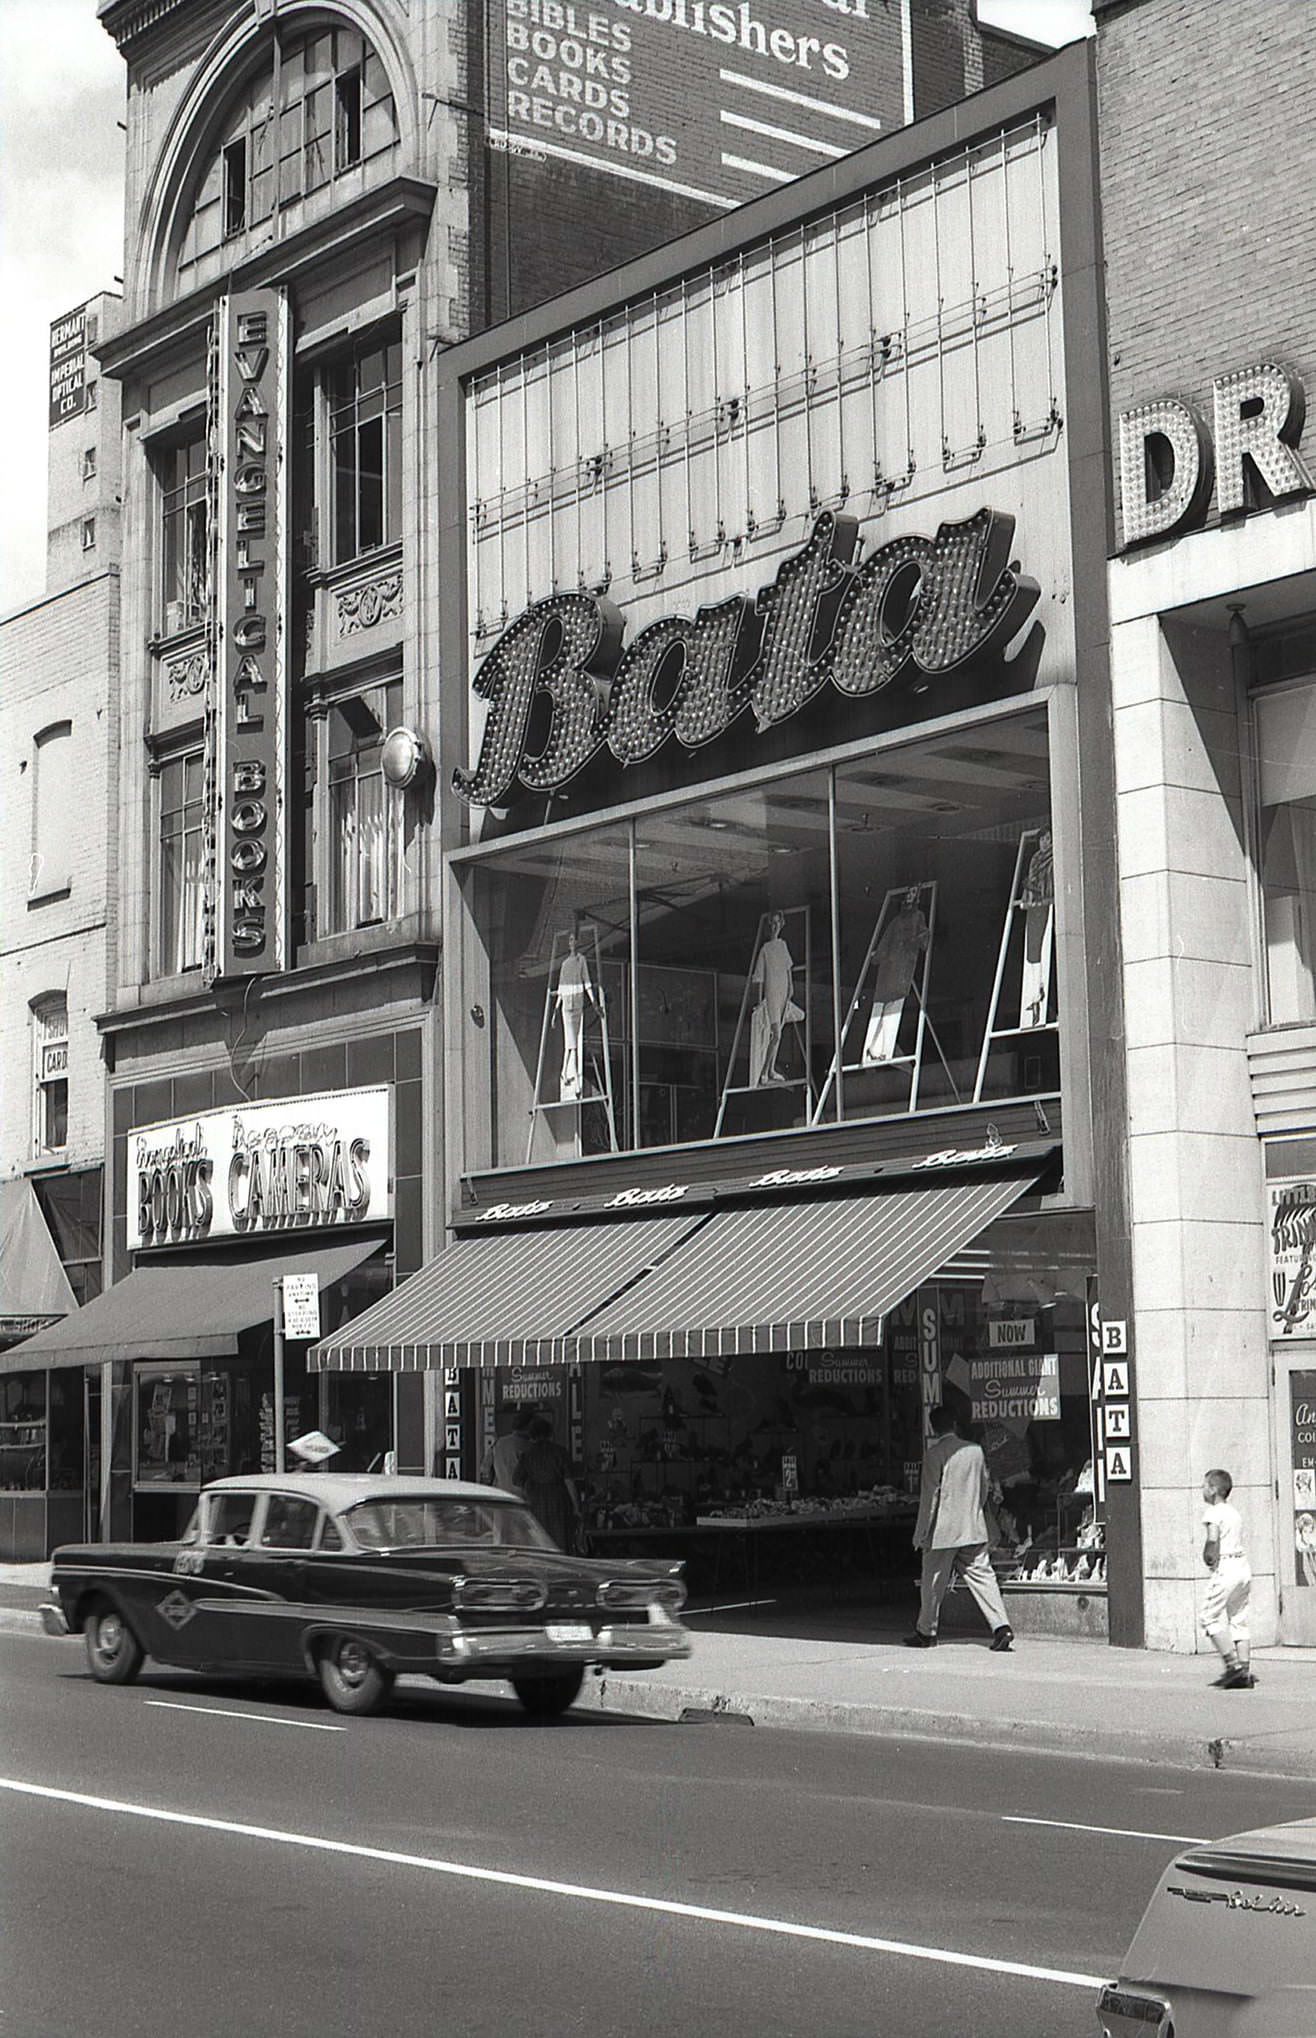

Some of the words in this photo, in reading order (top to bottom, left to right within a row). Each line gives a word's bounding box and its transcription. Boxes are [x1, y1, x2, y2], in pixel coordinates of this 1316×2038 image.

[507, 0, 632, 52] BIBLES
[507, 20, 632, 85] BOOKS
[507, 57, 631, 118] CARDS
[507, 91, 677, 164] RECORDS
[52, 372, 83, 402] OPTICAL
[60, 395, 77, 414] CO.
[1119, 362, 1316, 545] DR
[233, 311, 269, 731] EVANGELICAL
[450, 504, 1041, 806] Bata
[230, 759, 268, 957] BOOKS
[911, 1145, 1018, 1169] Bata
[227, 1138, 371, 1226] CAMERAS
[749, 1165, 845, 1188] Bata
[138, 1158, 214, 1238] BOOKS
[474, 1199, 553, 1221] Bata
[603, 1183, 688, 1209] Bata
[997, 1323, 1026, 1344] NOW
[809, 1368, 883, 1384] REDUCTIONS
[971, 1359, 1026, 1380] ADDITIONAL
[1028, 1357, 1057, 1377] GIANT
[502, 1382, 562, 1400] REDUCTIONS
[983, 1379, 1046, 1399] Summer
[1106, 1325, 1127, 1475] BATA
[972, 1397, 1058, 1419] REDUCTIONS
